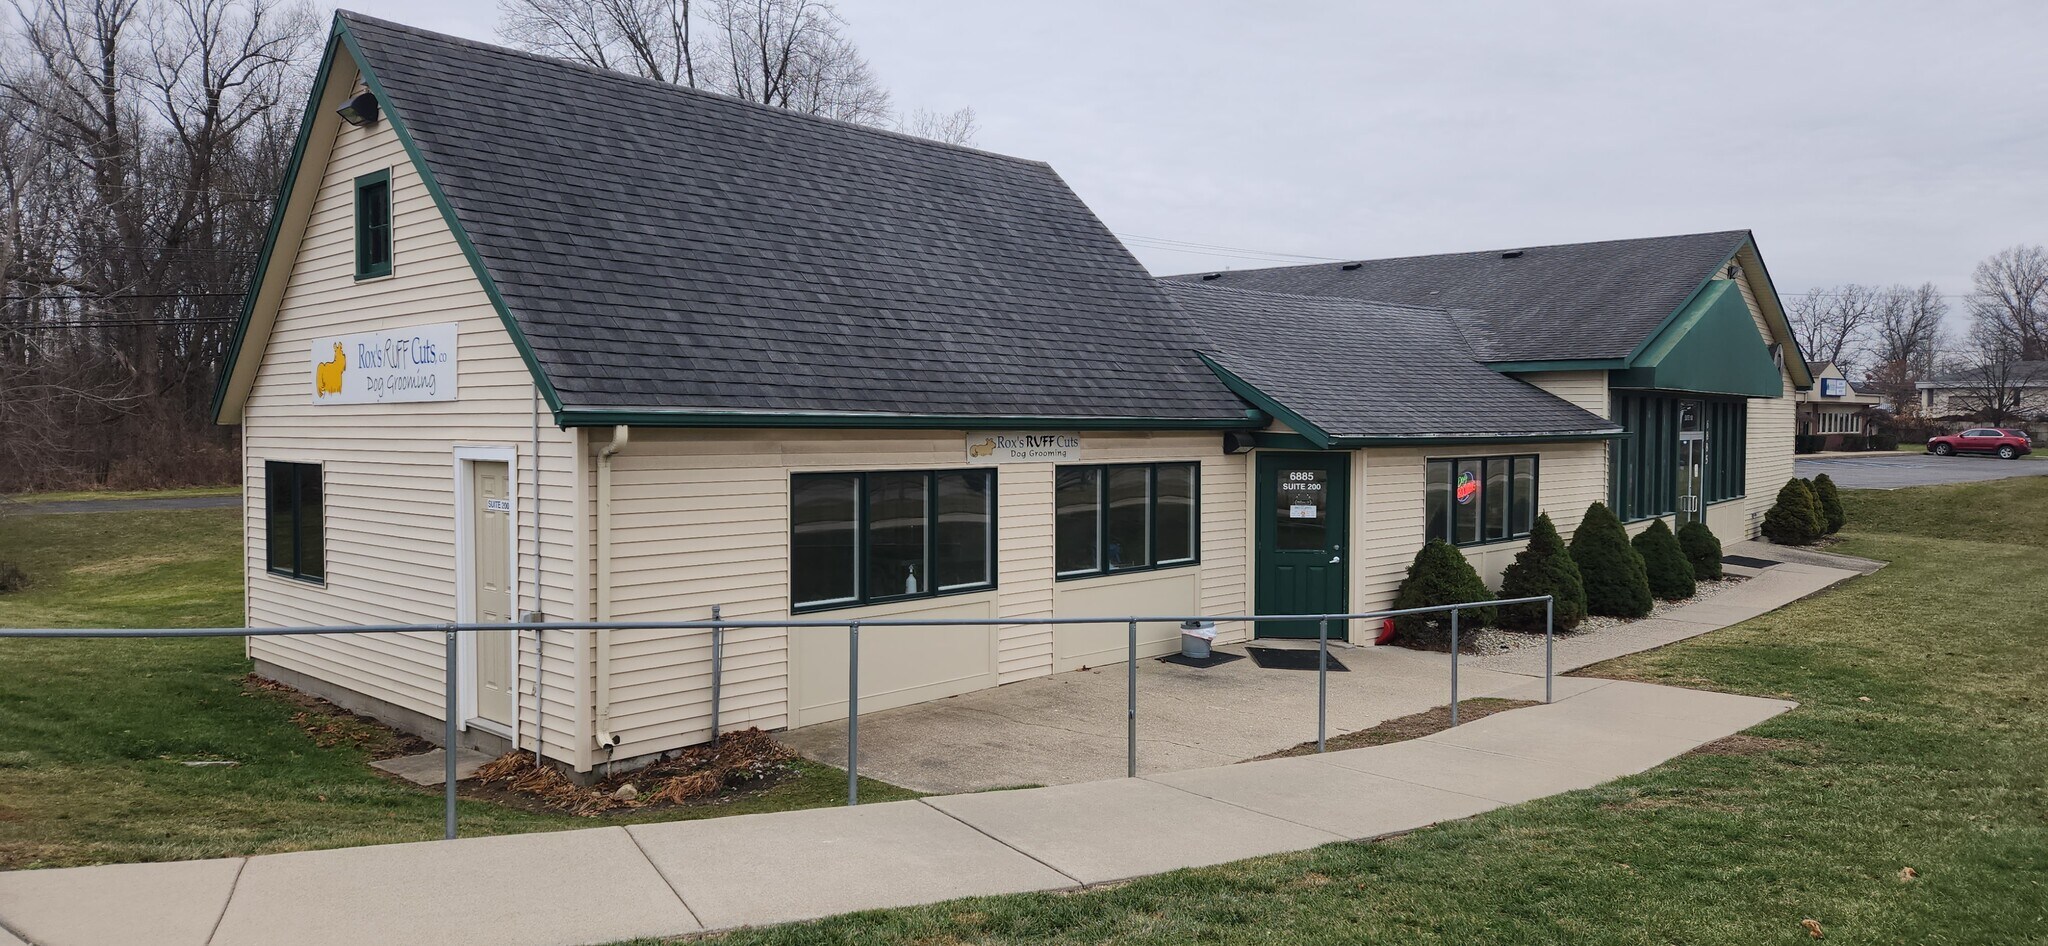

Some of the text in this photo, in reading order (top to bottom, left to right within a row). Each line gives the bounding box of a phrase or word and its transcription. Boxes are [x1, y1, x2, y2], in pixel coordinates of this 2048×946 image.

[358, 343, 382, 369] Rox's
[366, 368, 436, 398] Dog Grooming
[997, 435, 1079, 449] Rox's RUFF Cuts
[1010, 449, 1067, 459] Dog Grooming
[1290, 471, 1314, 481] 6885
[1282, 482, 1306, 490] SUITE
[488, 499, 510, 510] SUITE 200
